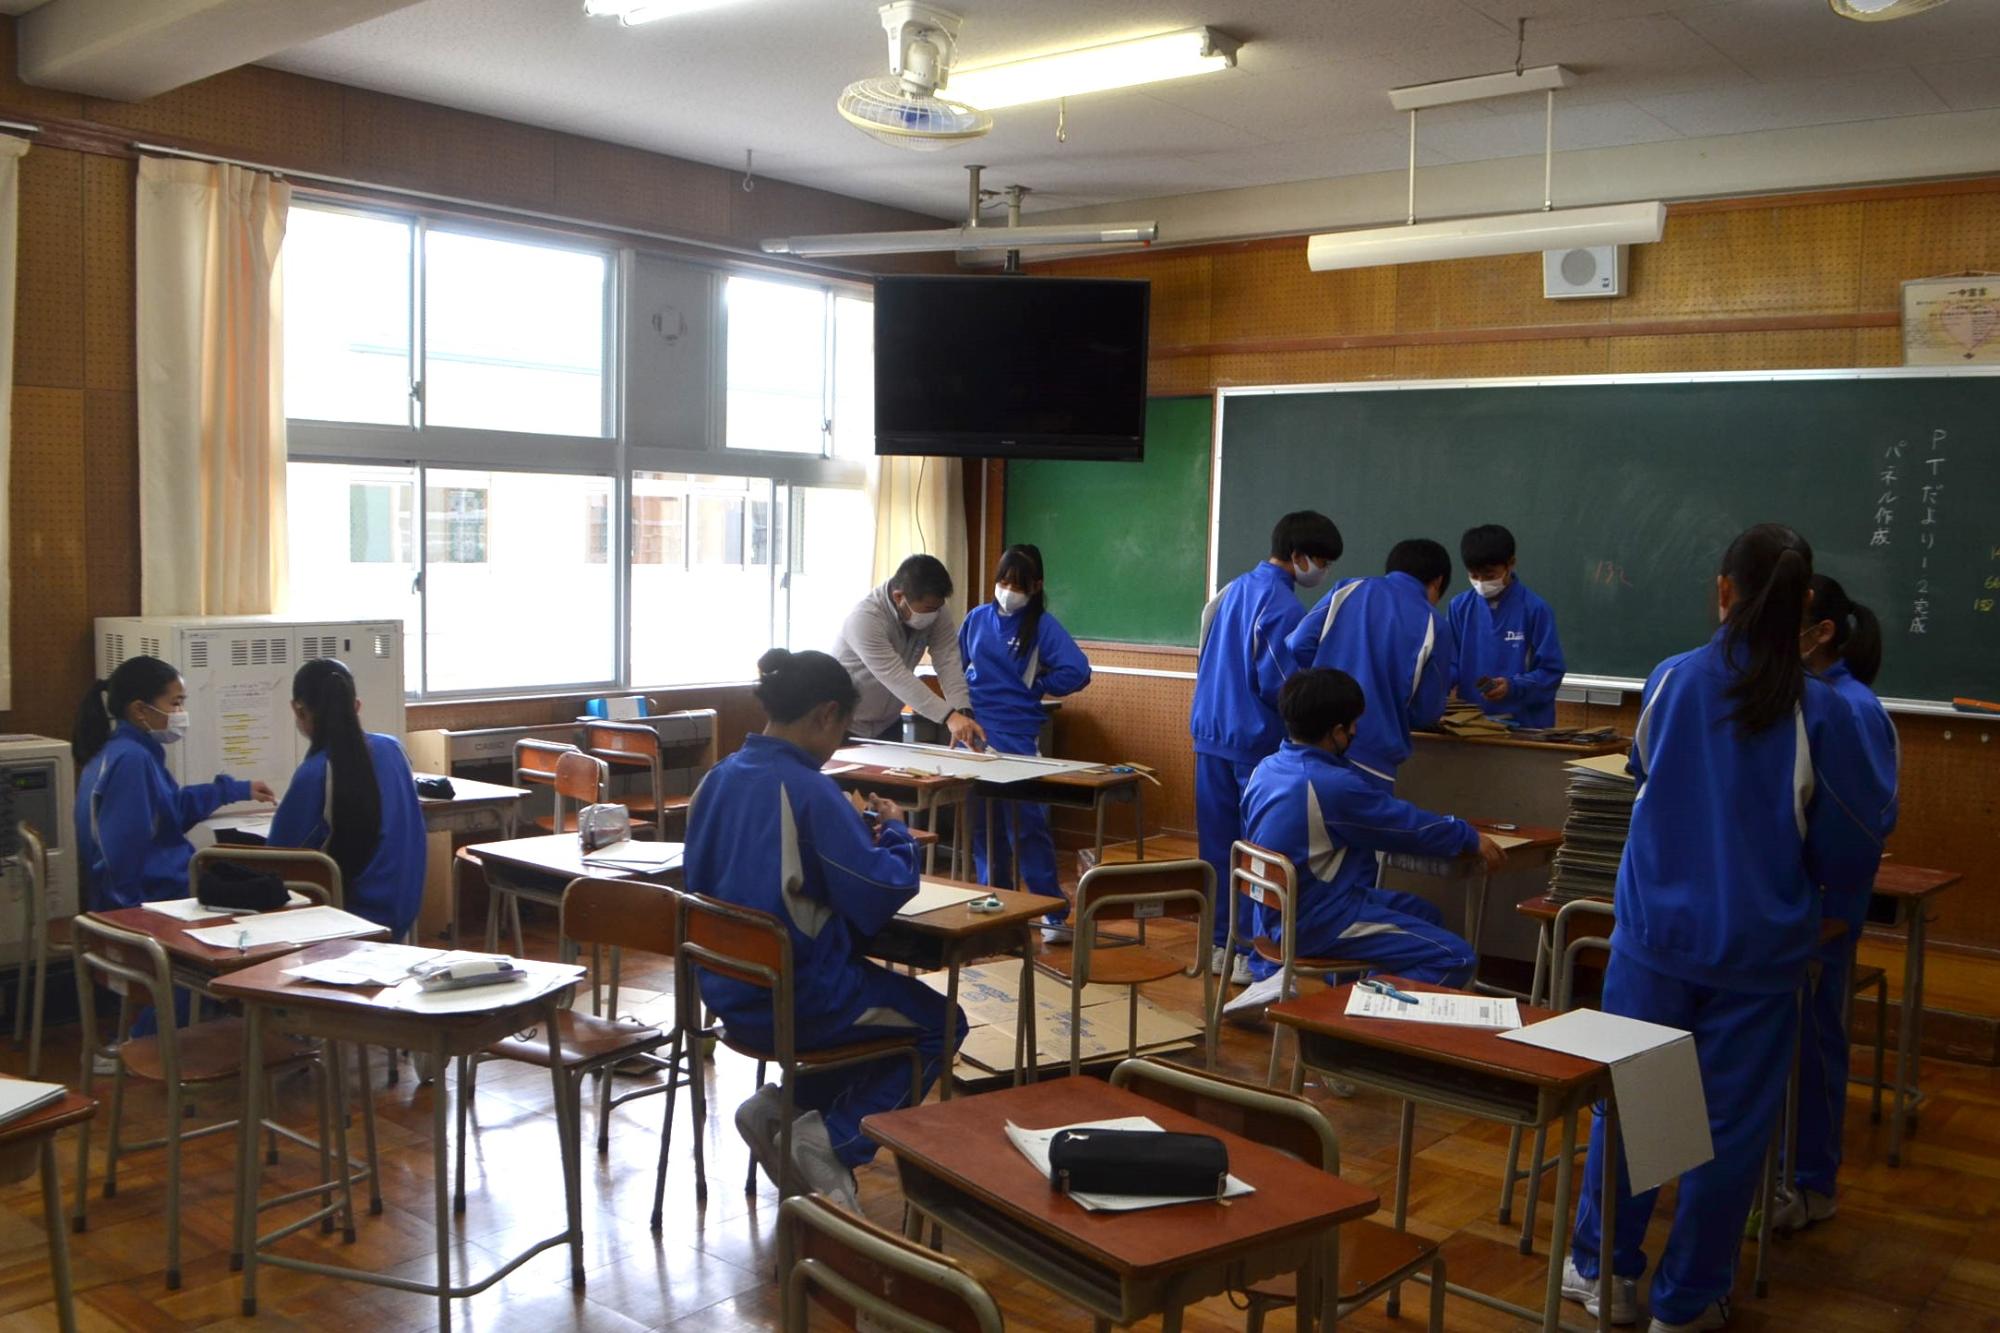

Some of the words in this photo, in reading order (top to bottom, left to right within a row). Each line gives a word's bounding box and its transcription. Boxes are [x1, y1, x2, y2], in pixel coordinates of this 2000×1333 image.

[1869, 440, 1908, 546] パネル作成
